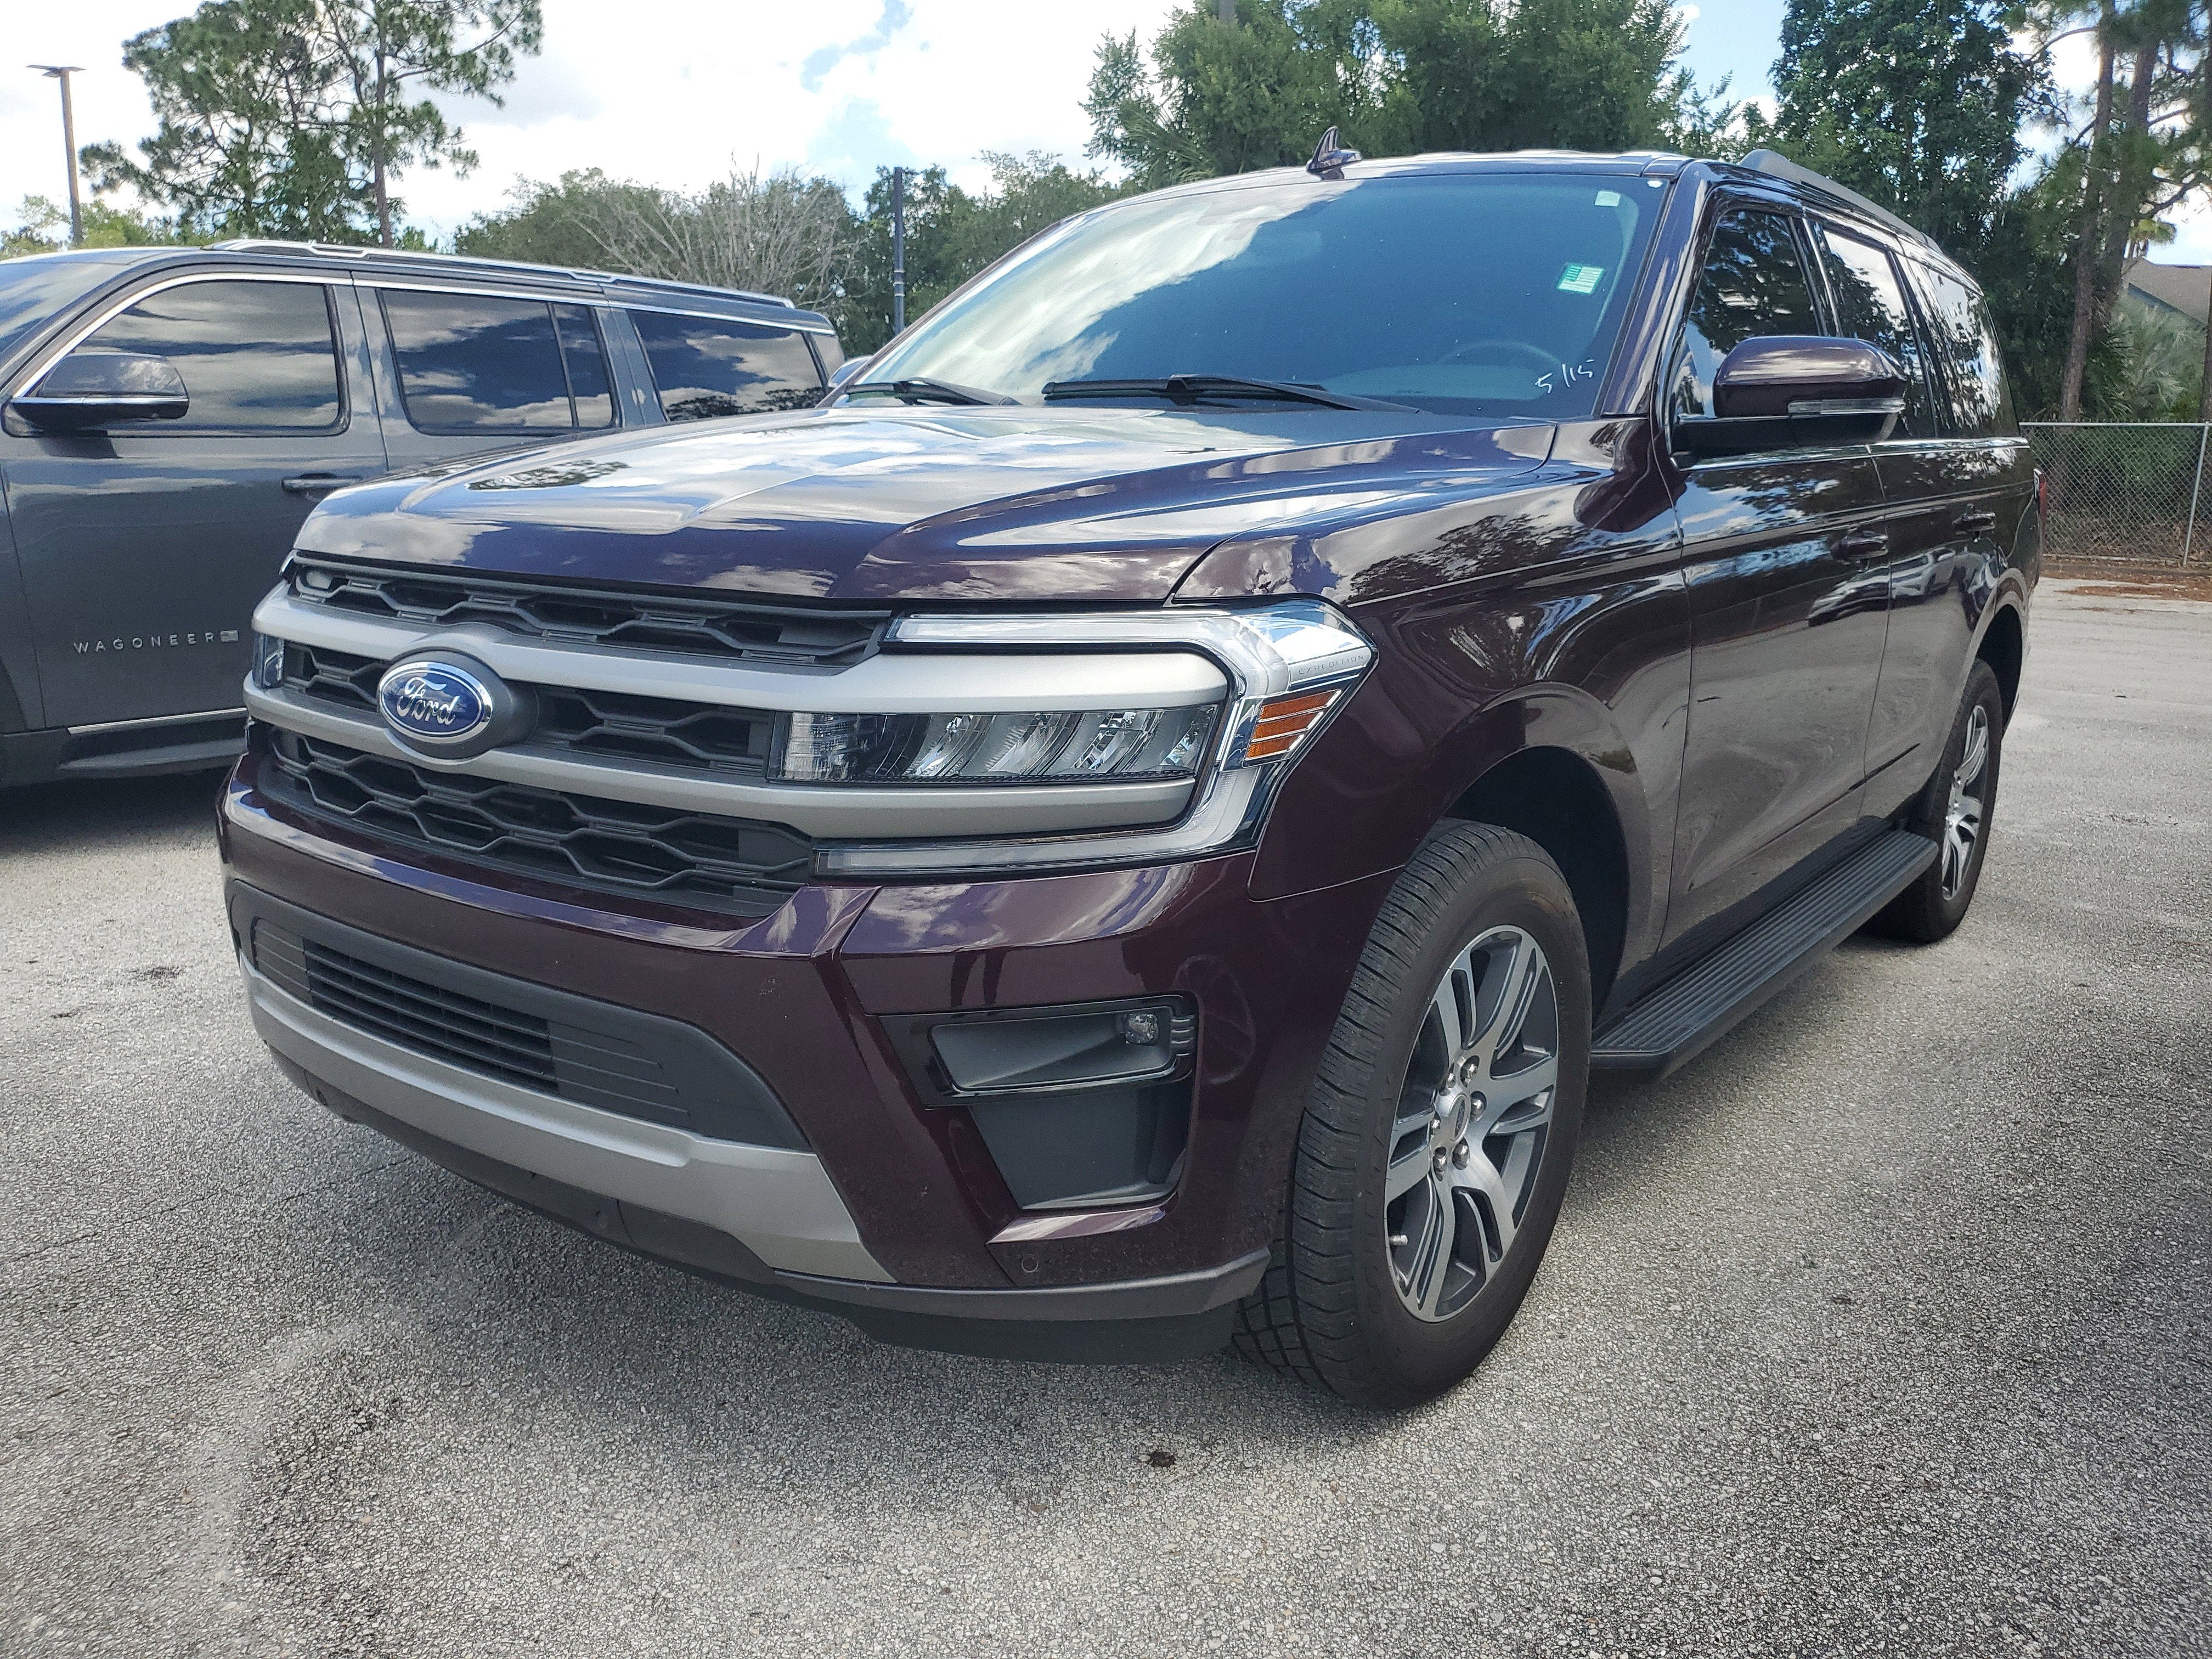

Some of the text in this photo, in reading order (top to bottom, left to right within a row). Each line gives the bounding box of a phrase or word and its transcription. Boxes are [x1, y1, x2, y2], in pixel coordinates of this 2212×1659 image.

[74, 631, 215, 654] WAGONEER
[1299, 654, 1364, 675] EXPEDITION
[397, 676, 460, 725] Ford
